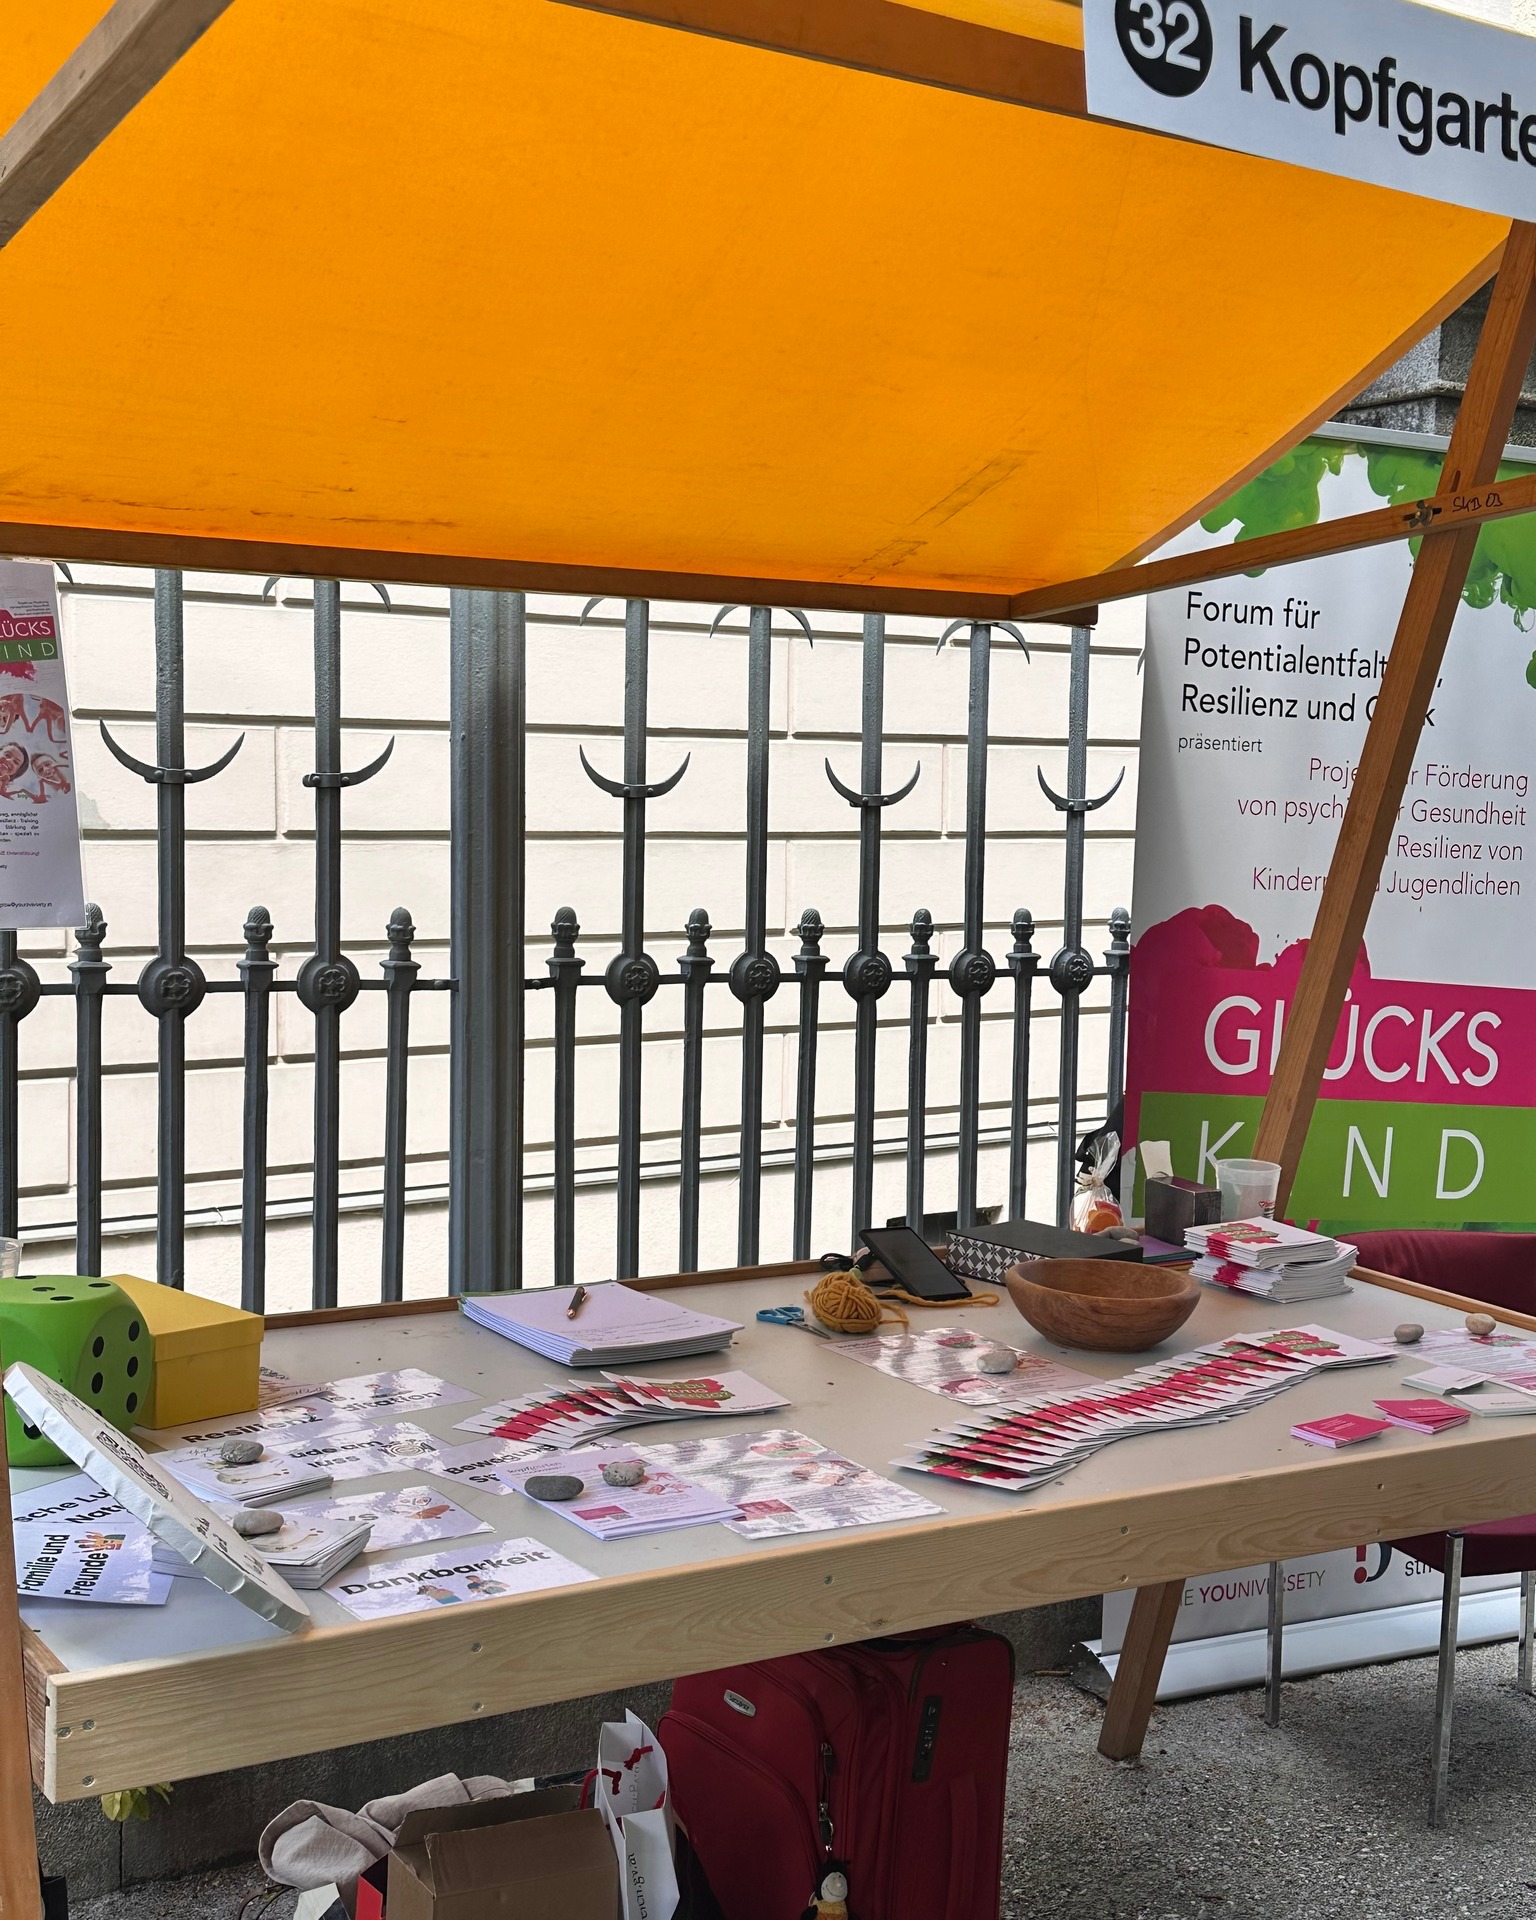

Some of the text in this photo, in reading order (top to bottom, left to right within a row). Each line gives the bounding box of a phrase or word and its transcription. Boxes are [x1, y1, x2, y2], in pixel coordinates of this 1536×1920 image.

[1128, 0, 1201, 71] 32
[1187, 590, 1321, 629] Forum für
[1182, 683, 1298, 718] Resilienz
[1307, 692, 1356, 722] und
[1178, 732, 1263, 753] präsentiert
[1425, 763, 1529, 797] Förderung
[1238, 799, 1277, 816] von
[1411, 799, 1527, 827] Gesundheit
[1397, 834, 1482, 860] Resilienz
[1488, 843, 1523, 861] von
[1386, 870, 1521, 901] Jugendlichen
[1197, 1120, 1485, 1199] KND
[181, 1416, 324, 1443] Resilienz
[443, 1443, 558, 1476] Bewegung
[17, 1534, 70, 1593] Familie und
[64, 1552, 110, 1597] Freunde
[339, 1549, 552, 1596] Dankbarkeit
